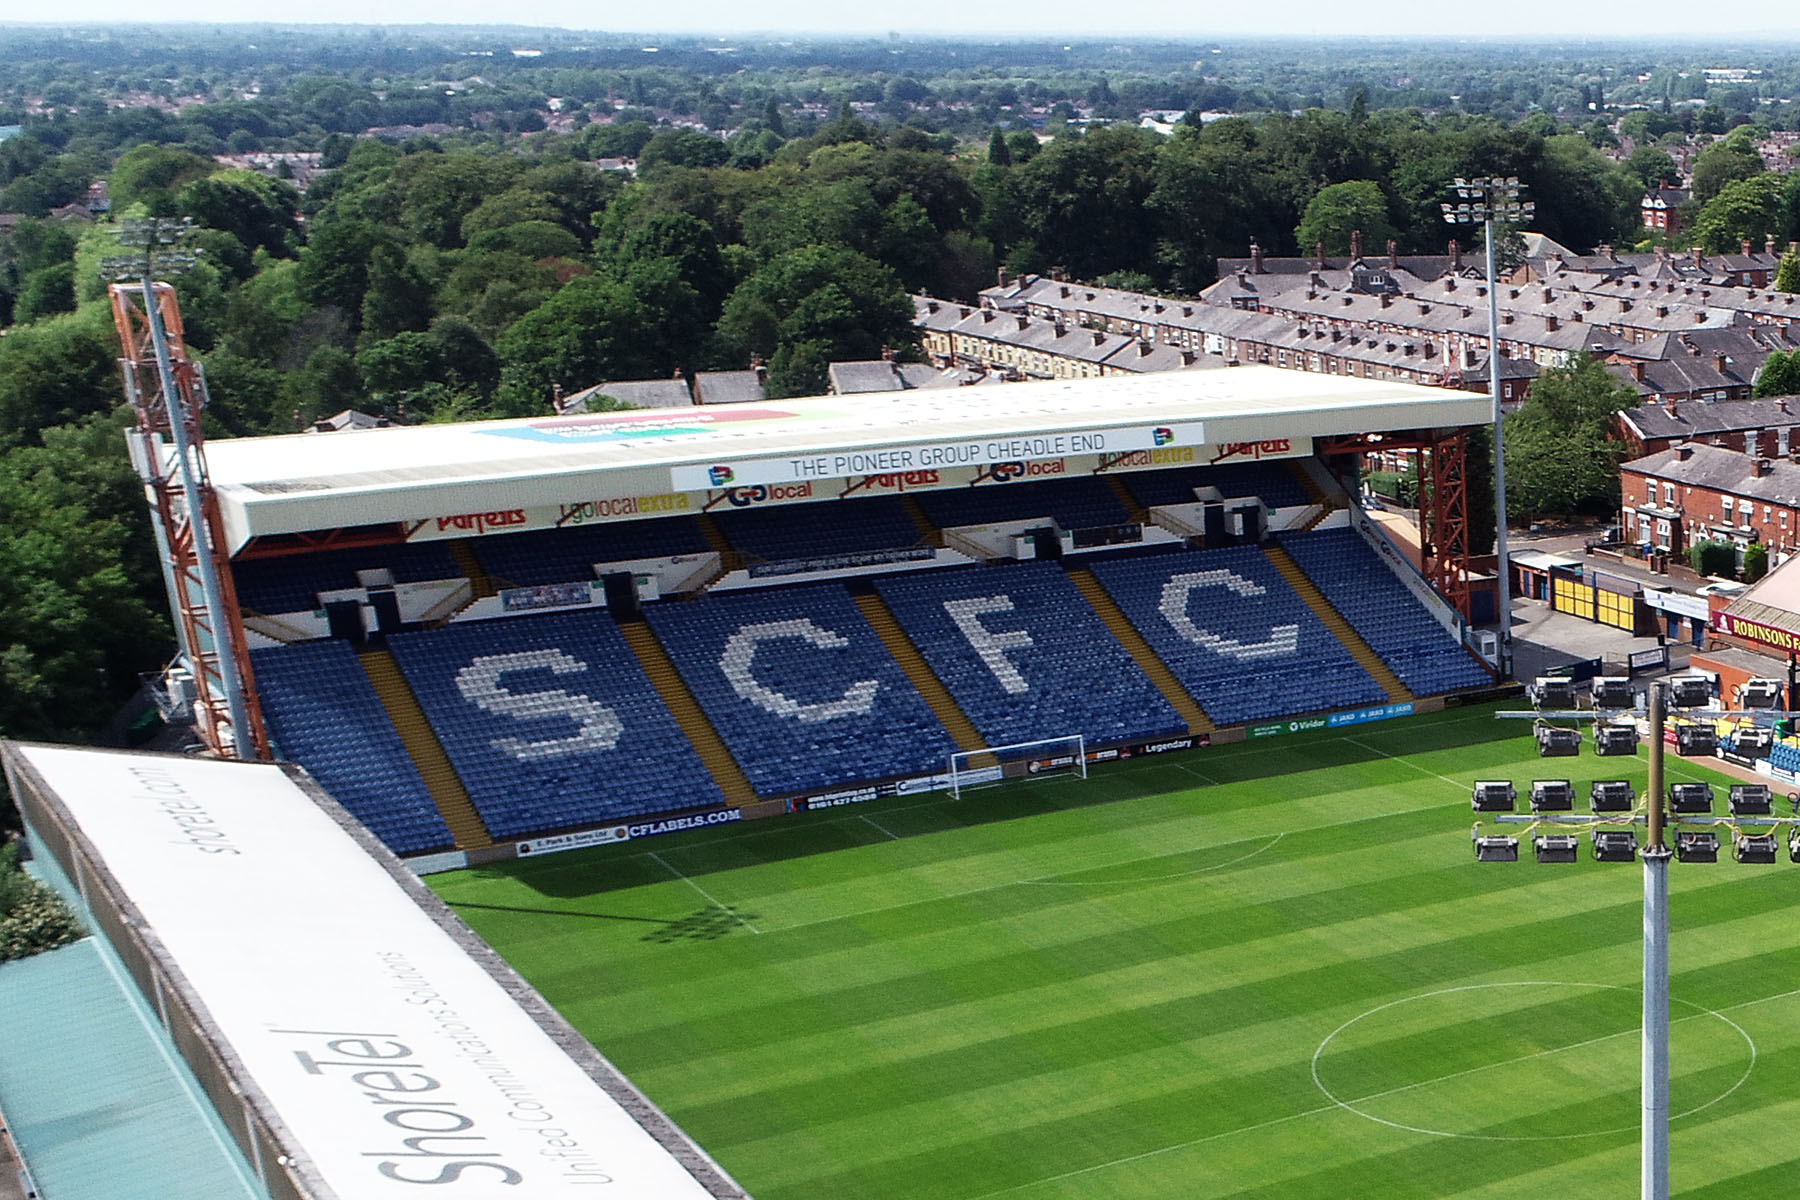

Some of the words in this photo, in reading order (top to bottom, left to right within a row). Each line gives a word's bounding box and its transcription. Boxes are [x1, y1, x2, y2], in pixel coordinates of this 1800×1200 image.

[791, 457, 828, 477] THE
[835, 449, 913, 474] PIONEER
[920, 444, 980, 466] GROUP
[987, 436, 1064, 460] CHEADLE
[1072, 433, 1105, 451] END
[1733, 618, 1792, 650] ROBINSONS
[1146, 738, 1192, 753] Legendary
[629, 808, 741, 838] CFLABELS.COM
[428, 1009, 553, 1123] Communications
[270, 1028, 524, 1186] ShoreTel
